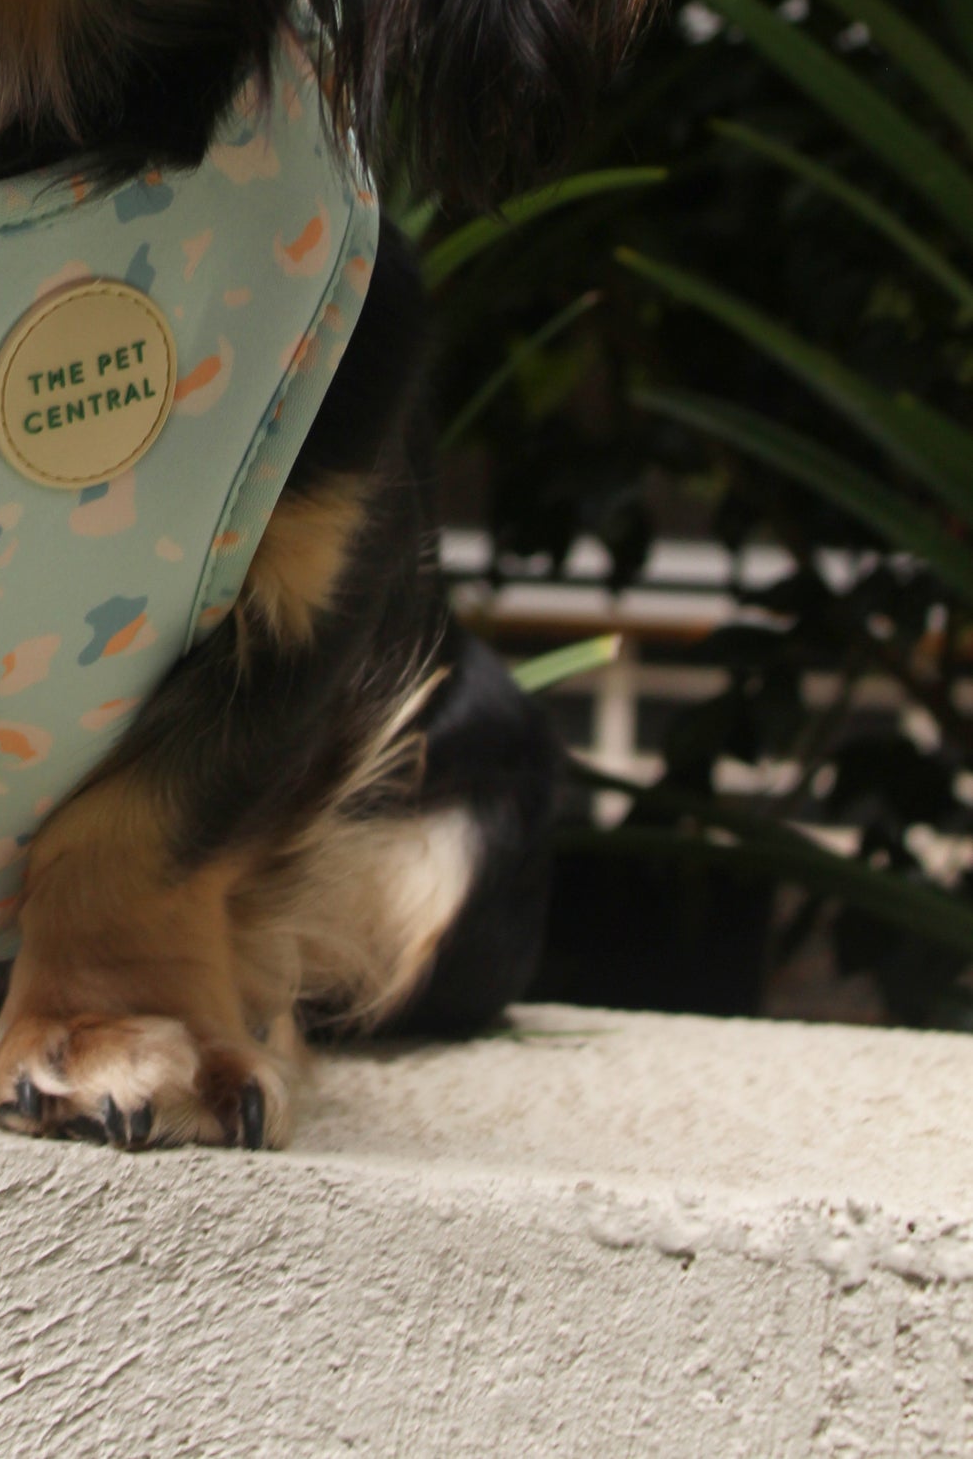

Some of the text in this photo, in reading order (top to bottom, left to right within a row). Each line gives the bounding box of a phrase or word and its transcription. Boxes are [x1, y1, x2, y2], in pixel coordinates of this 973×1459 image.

[28, 340, 146, 396] THE PET
[24, 377, 156, 435] CENTRAL
